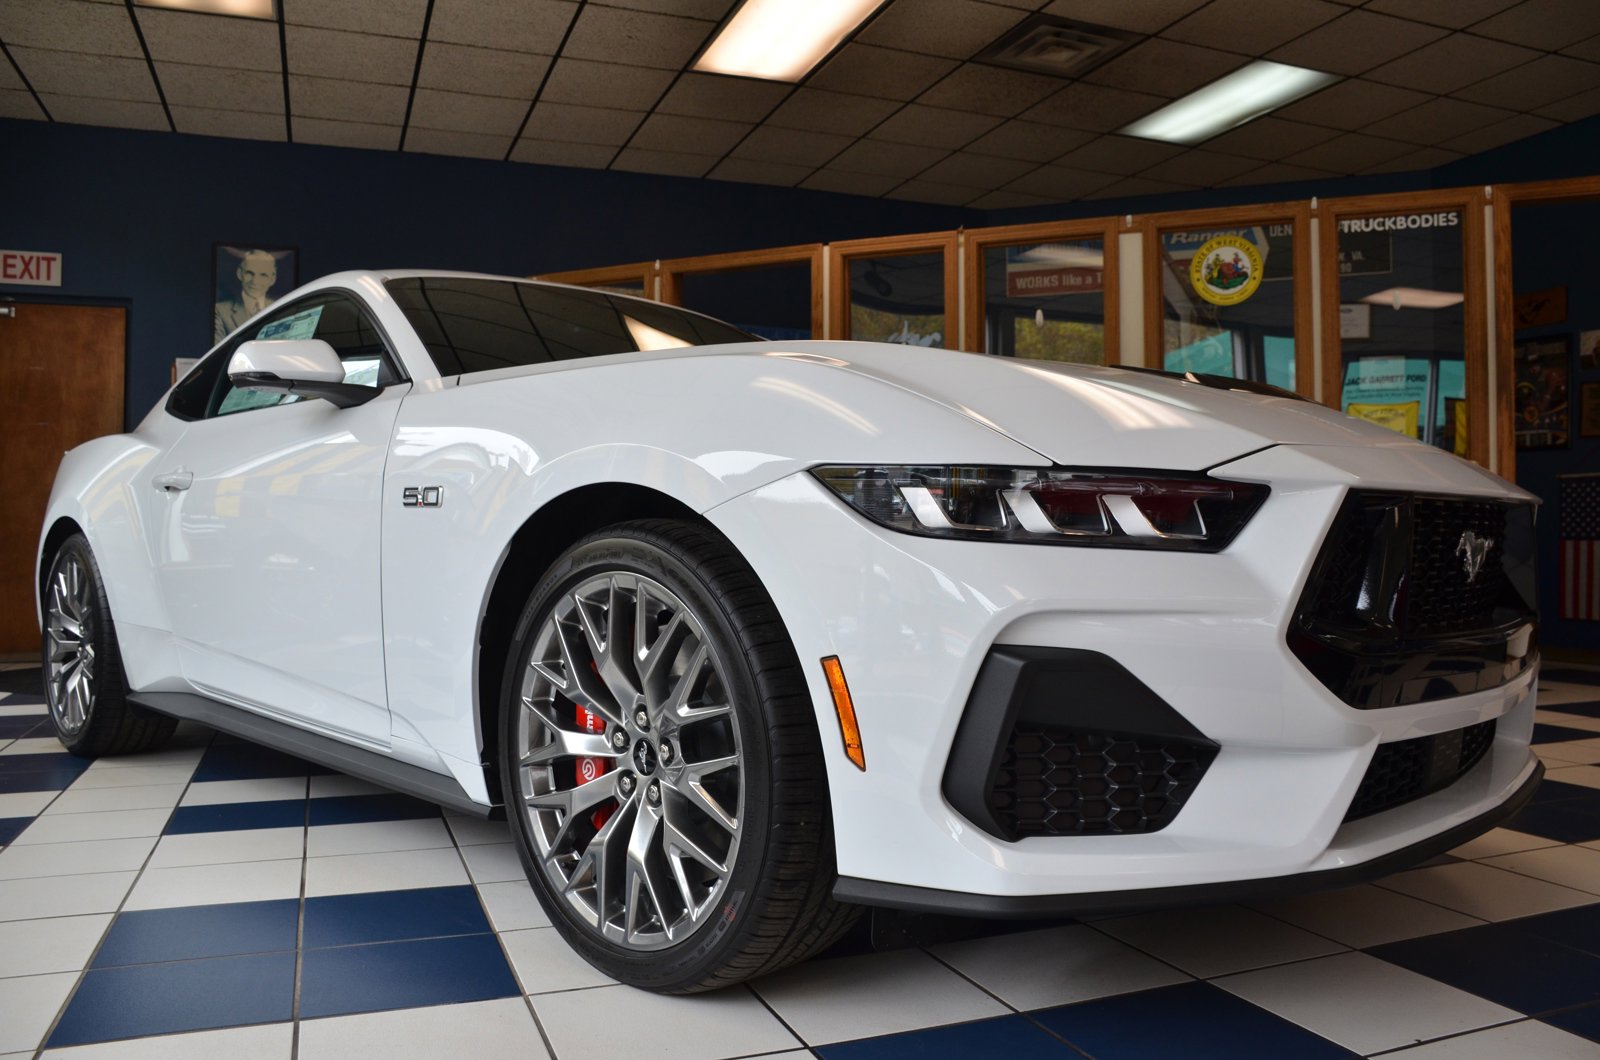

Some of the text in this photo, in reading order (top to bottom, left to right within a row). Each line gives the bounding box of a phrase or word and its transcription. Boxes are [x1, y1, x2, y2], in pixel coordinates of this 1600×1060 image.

[1342, 212, 1458, 234] TRUCKBODIES
[3, 254, 57, 281] EXIT
[1016, 275, 1058, 289] WORKS
[1062, 274, 1081, 286] like
[1085, 276, 1092, 285] a
[1406, 374, 1427, 383] FORD
[402, 485, 444, 508] 5.0
